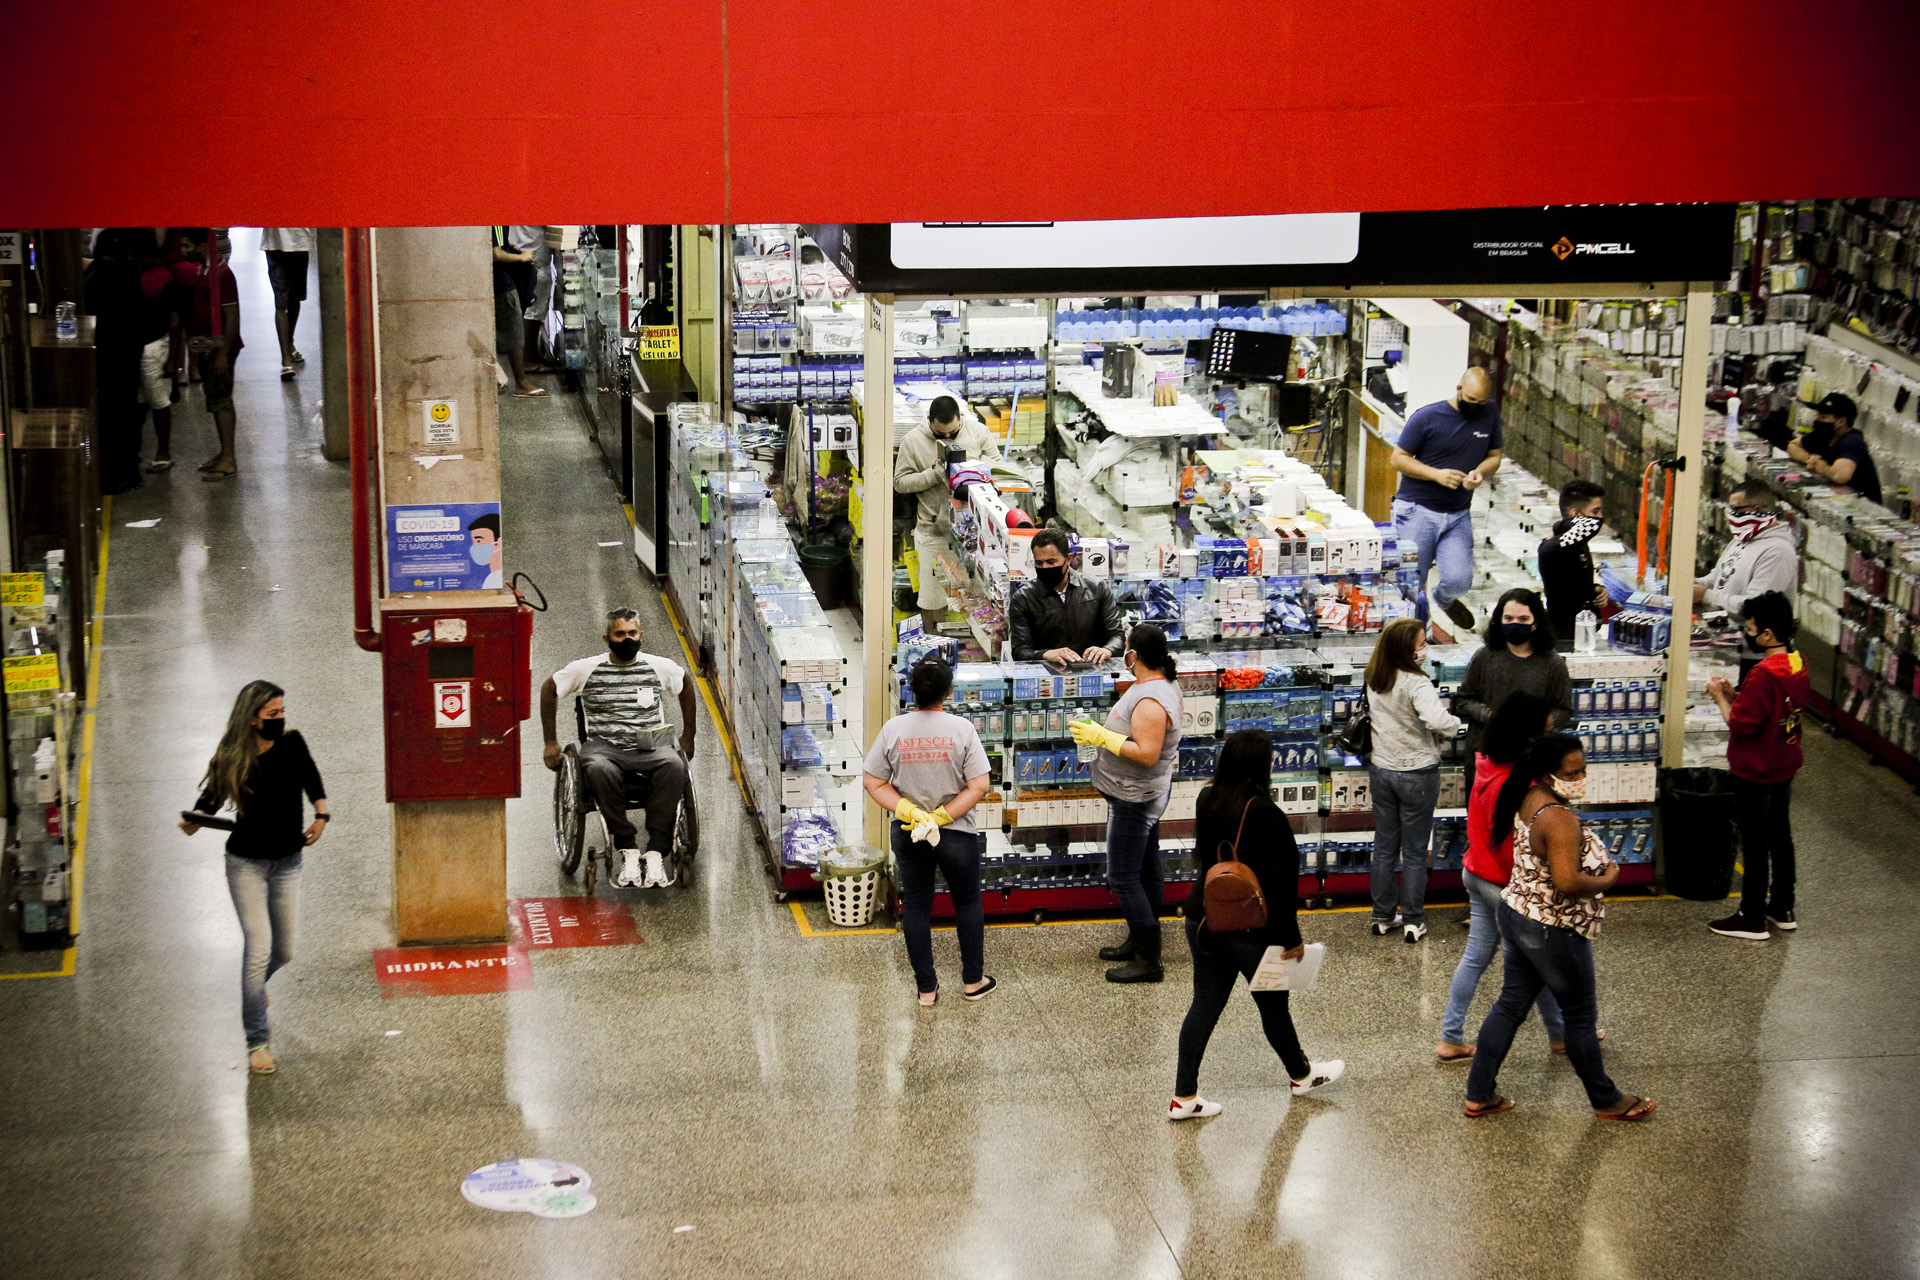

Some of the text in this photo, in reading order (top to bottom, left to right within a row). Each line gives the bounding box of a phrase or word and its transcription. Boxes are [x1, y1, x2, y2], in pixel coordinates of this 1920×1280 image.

[1576, 243, 1636, 255] PMCELL
[643, 340, 671, 349] TABLET
[401, 519, 454, 530] COVID-19
[397, 532, 465, 543] USO OBRIGATÓRIO
[397, 543, 408, 551] DE
[901, 751, 948, 760] 3372-9724
[523, 901, 554, 945] EXTINTOR
[558, 915, 580, 929] DE
[386, 956, 517, 974] HIDRANTE
